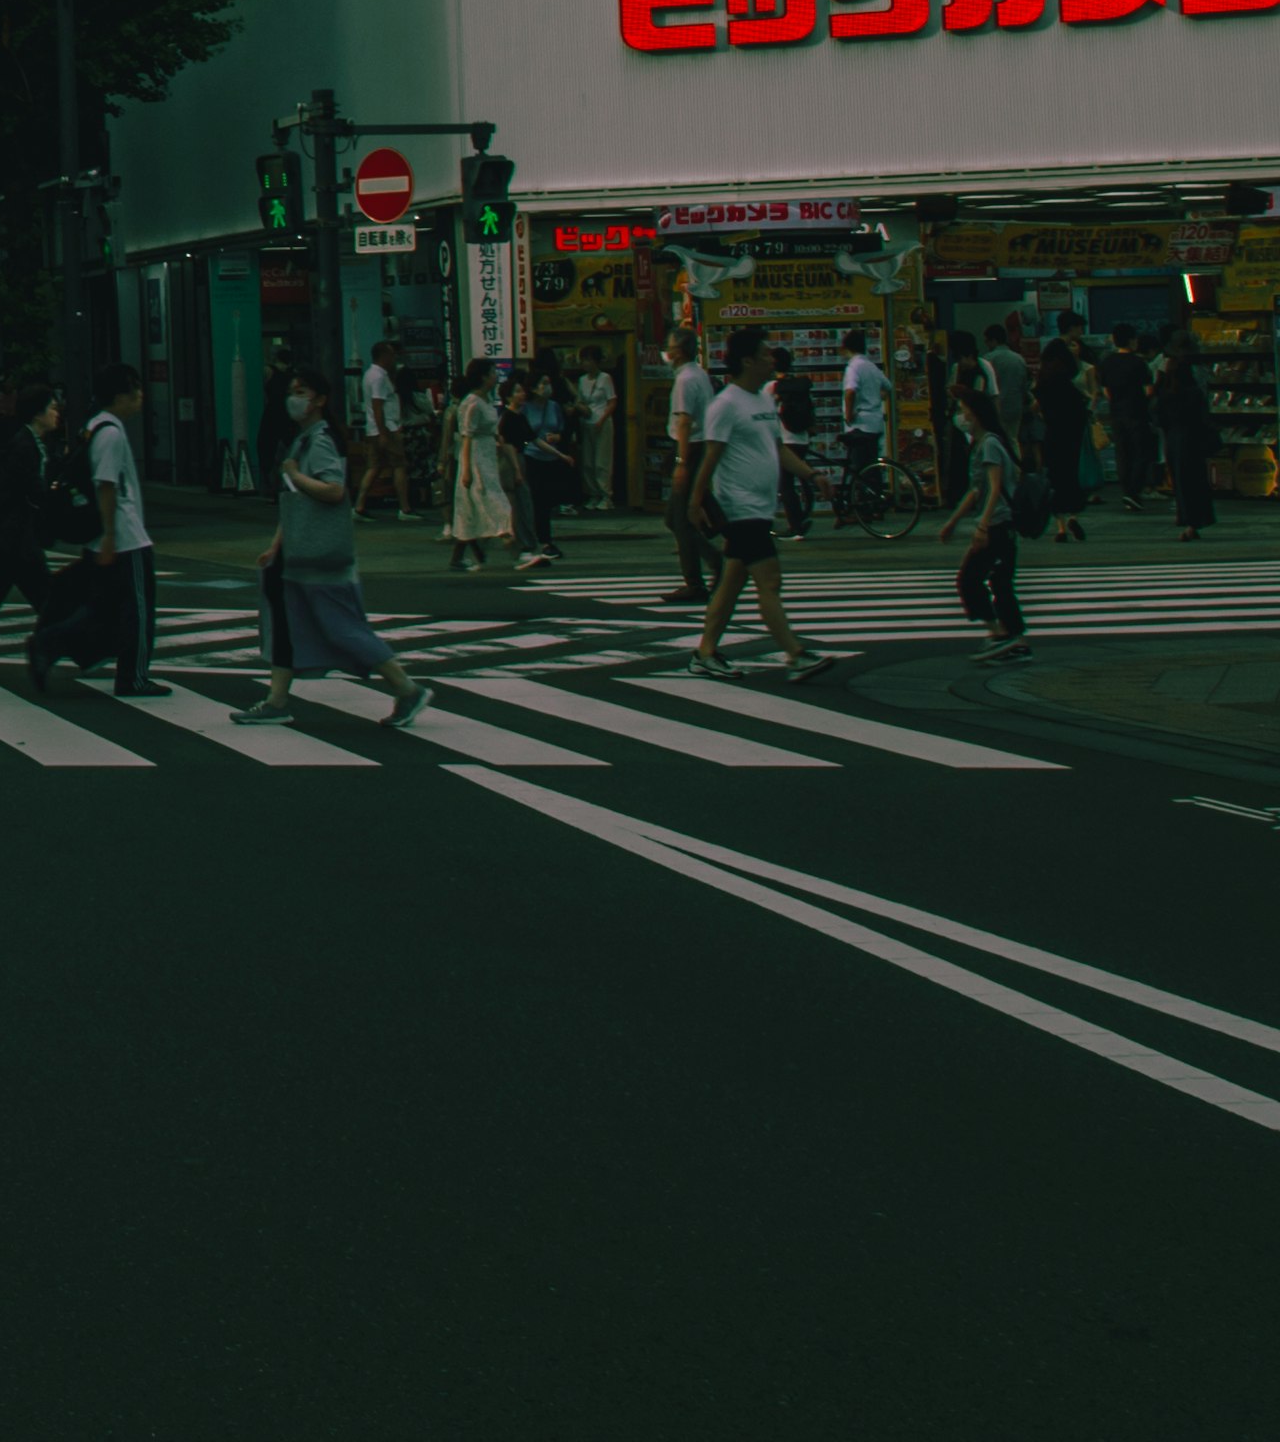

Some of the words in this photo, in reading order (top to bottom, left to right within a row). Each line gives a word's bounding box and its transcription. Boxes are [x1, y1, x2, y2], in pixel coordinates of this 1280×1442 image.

[799, 201, 832, 220] BIC
[358, 229, 413, 247] 自転車を除く
[1036, 236, 1139, 255] MUSEUM
[753, 271, 835, 288] MUSEUM
[484, 342, 503, 357] 3F
